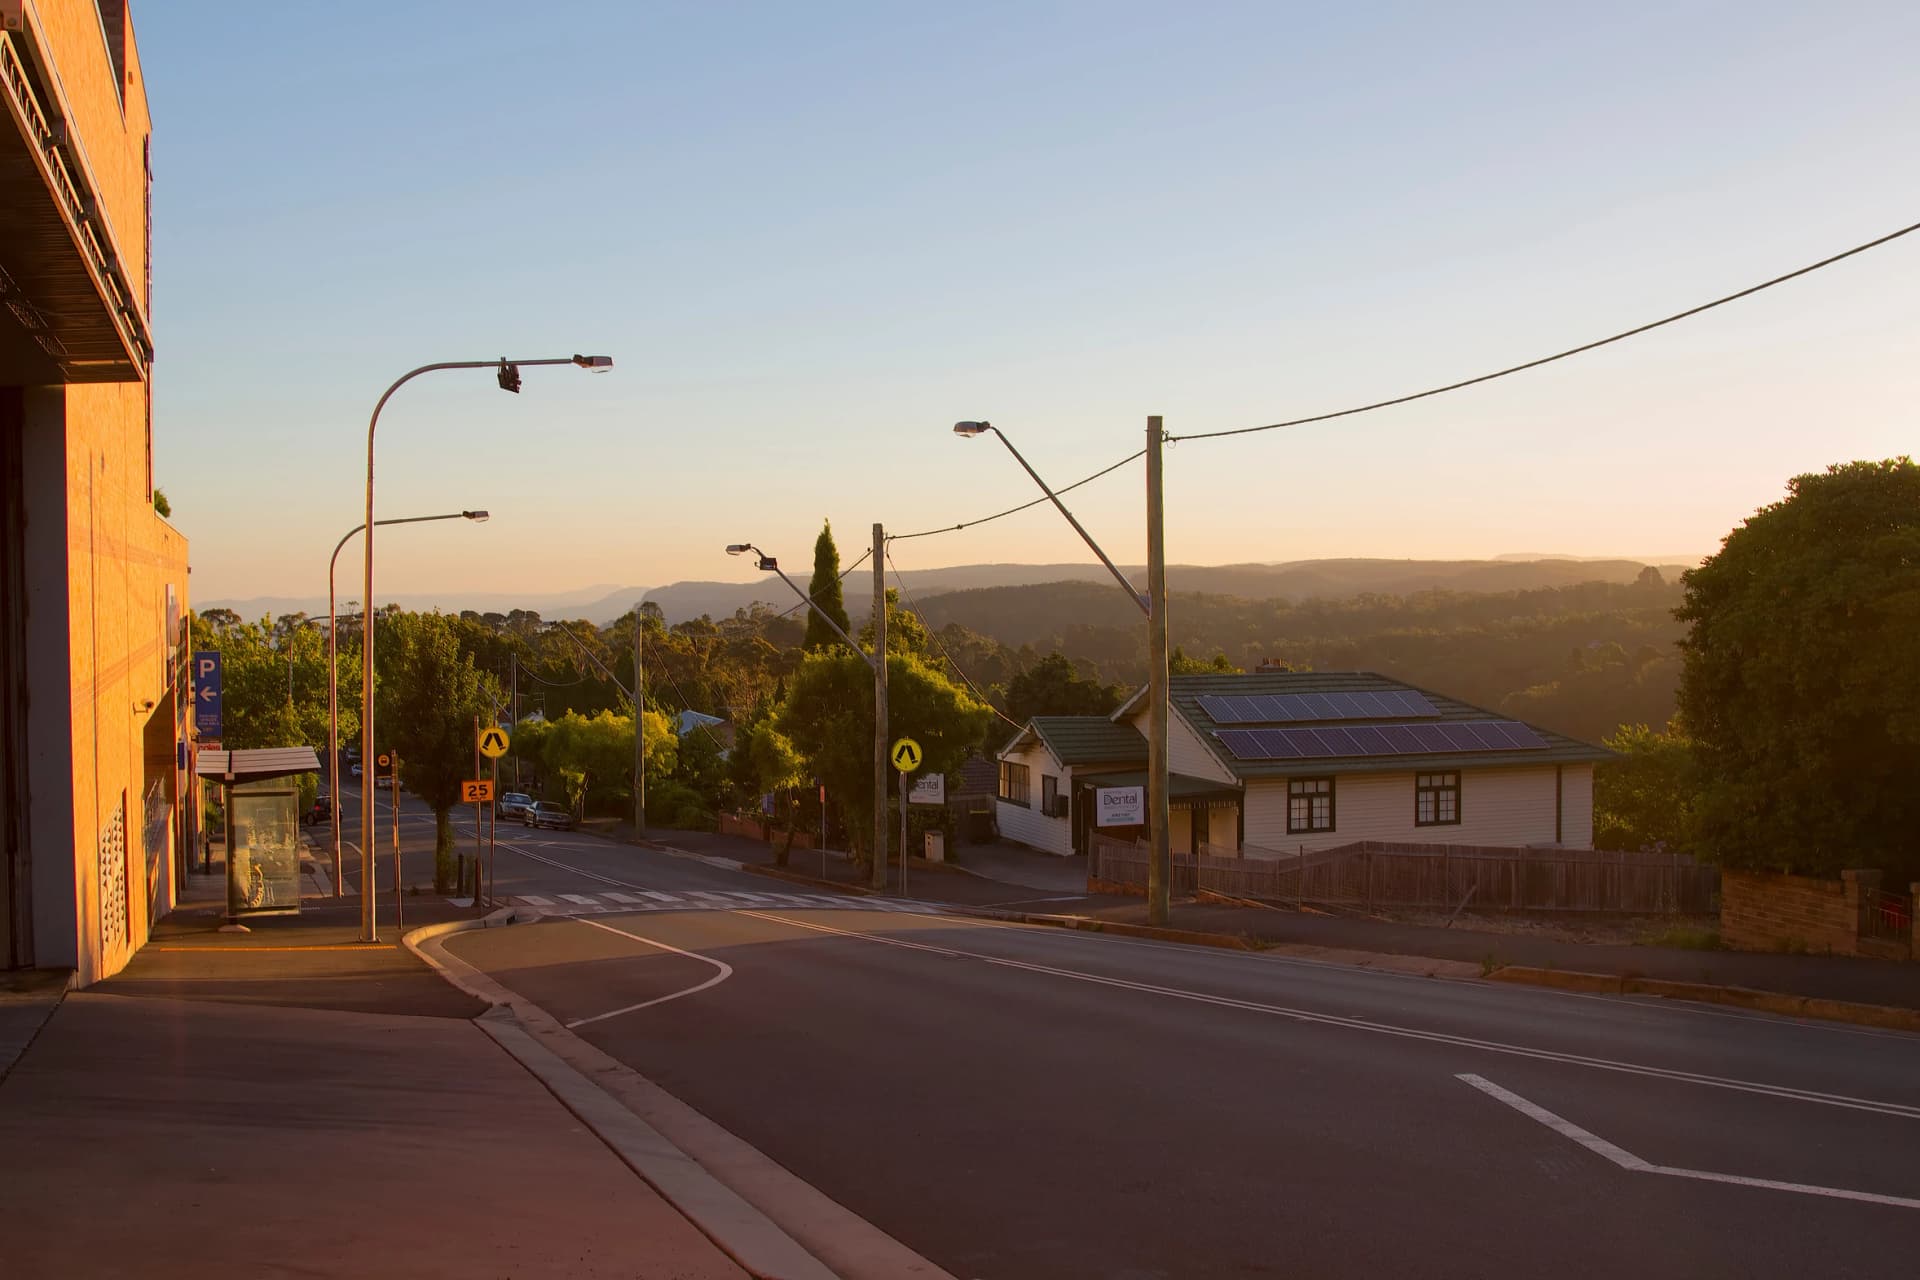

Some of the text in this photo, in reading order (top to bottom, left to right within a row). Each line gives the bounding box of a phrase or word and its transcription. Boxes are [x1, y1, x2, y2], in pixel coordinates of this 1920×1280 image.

[200, 659, 215, 678] P
[917, 777, 939, 790] ental
[468, 785, 488, 796] 25
[1103, 792, 1138, 805] Dental
